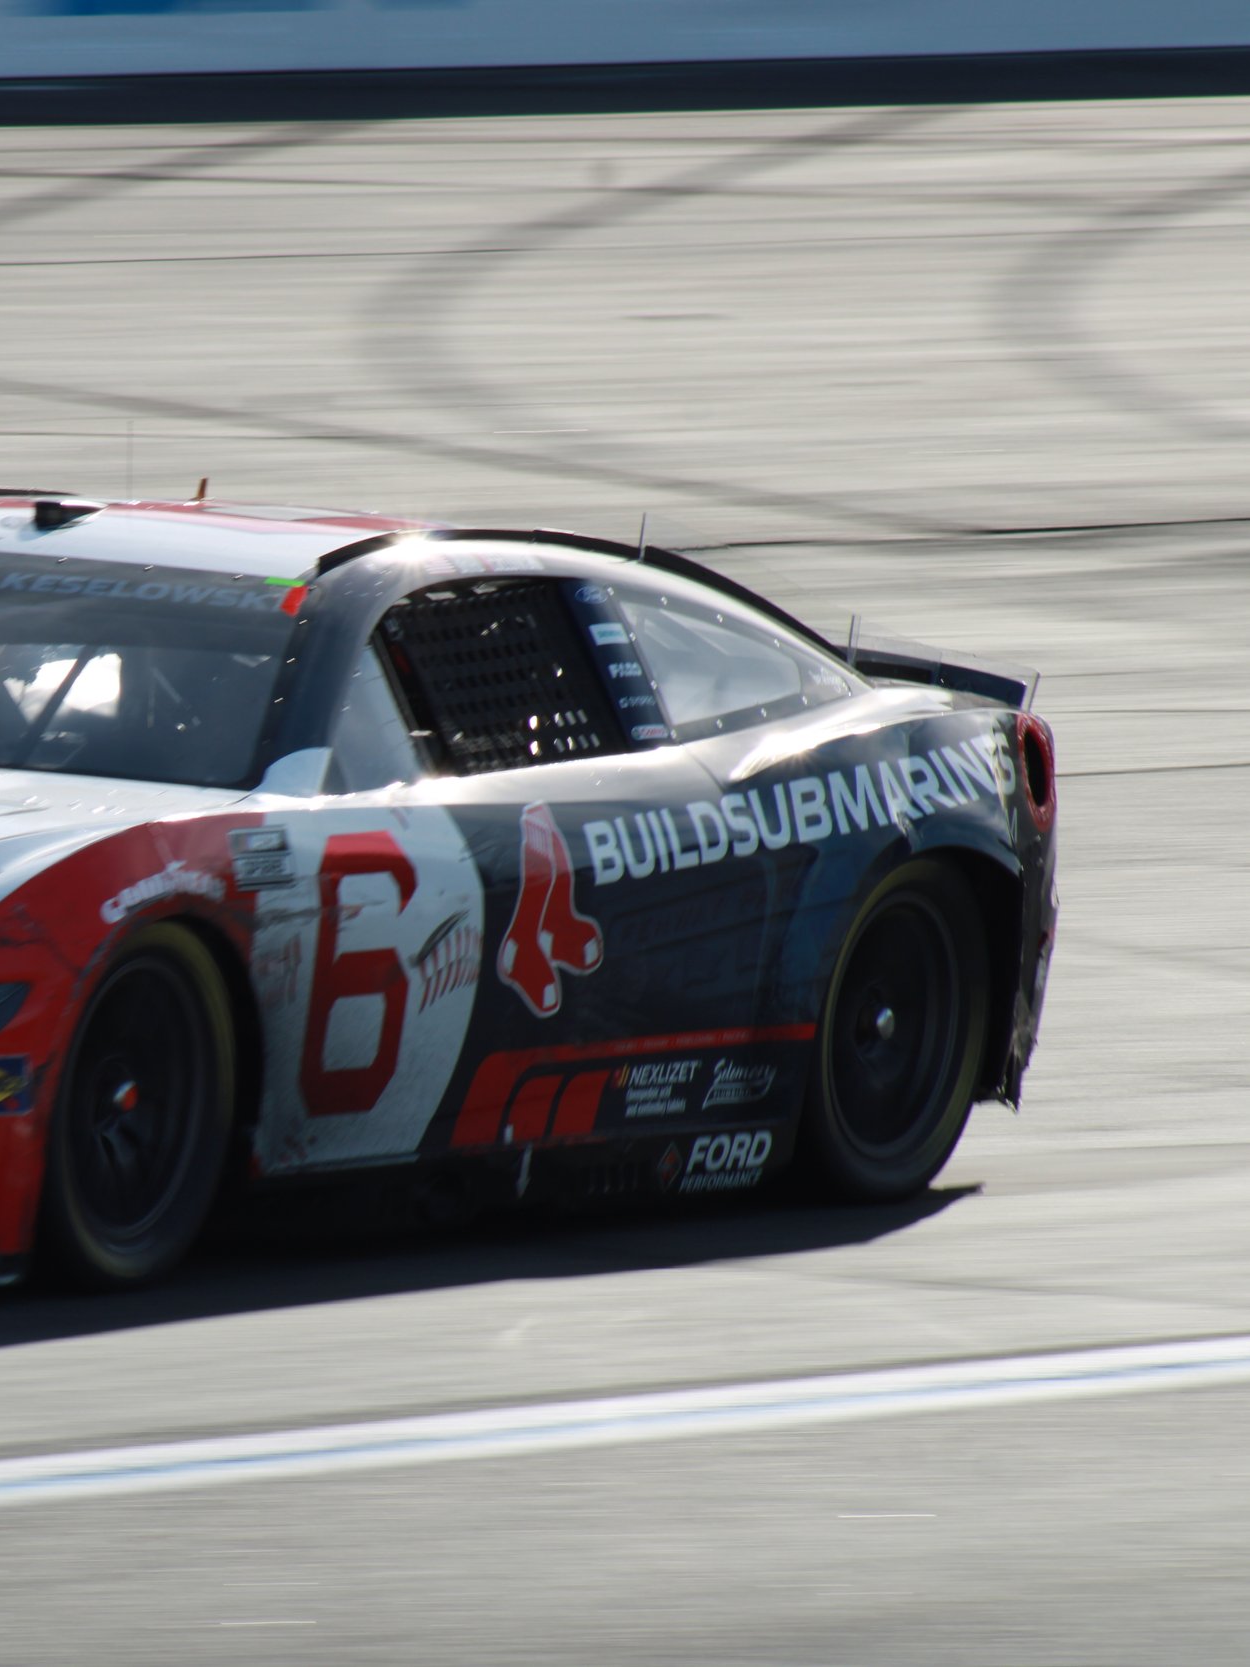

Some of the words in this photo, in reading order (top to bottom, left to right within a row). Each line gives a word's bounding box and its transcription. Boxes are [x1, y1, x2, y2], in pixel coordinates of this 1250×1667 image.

[299, 829, 419, 1119] 6
[629, 1059, 700, 1087] NEXLIZET
[686, 1129, 773, 1174] FORD
[679, 1166, 764, 1194] PERFORMANCE
